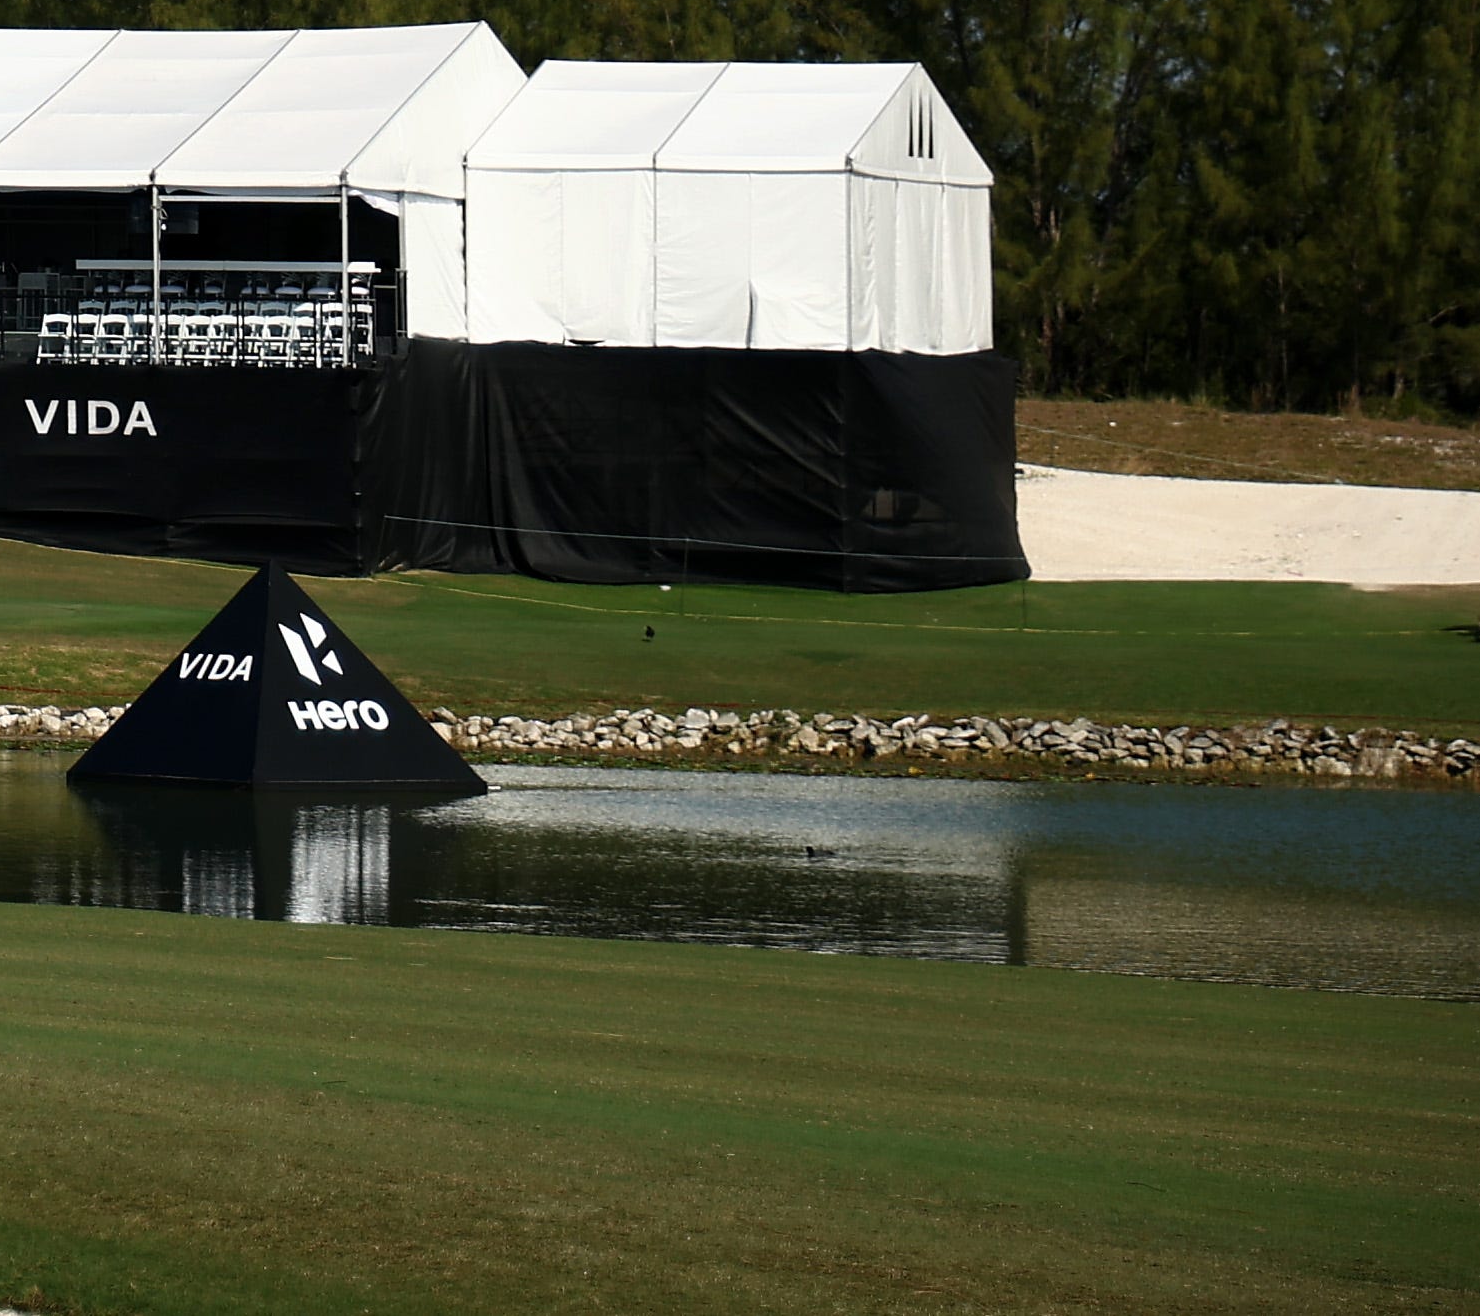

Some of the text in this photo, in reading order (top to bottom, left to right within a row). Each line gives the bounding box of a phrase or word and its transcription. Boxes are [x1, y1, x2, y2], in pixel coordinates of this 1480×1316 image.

[24, 399, 158, 437] VIDA
[178, 652, 254, 682] VIDA
[287, 699, 390, 731] Hero
